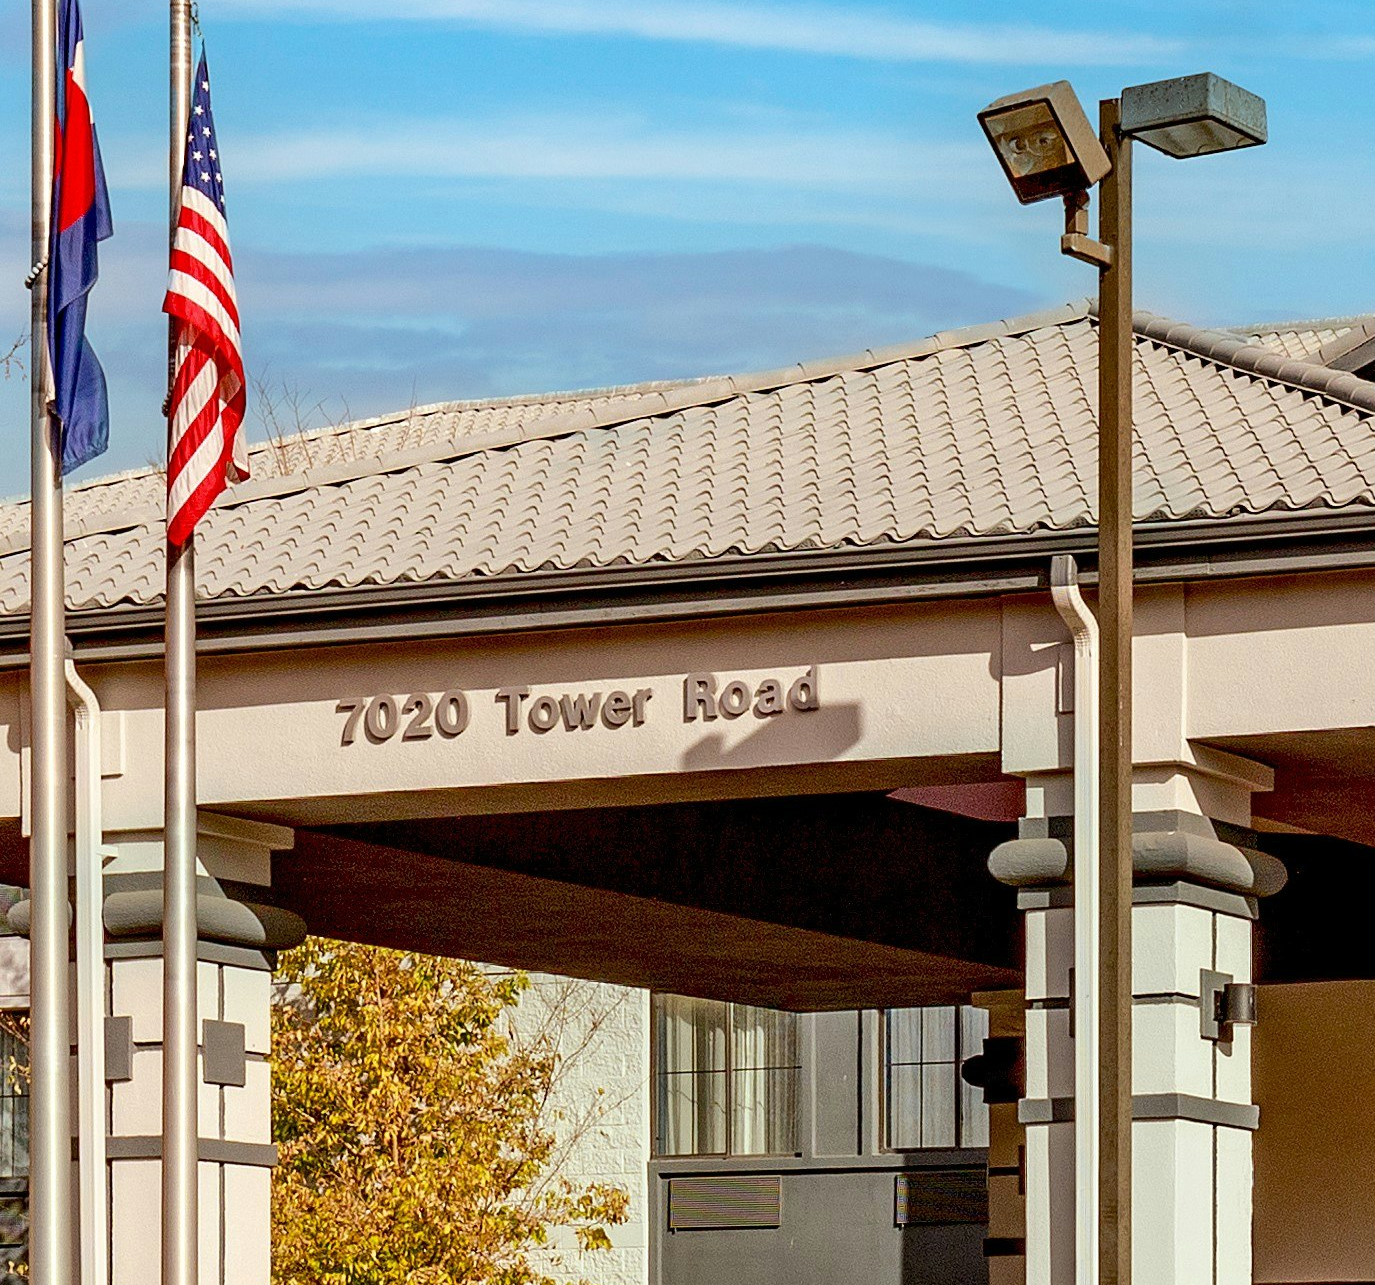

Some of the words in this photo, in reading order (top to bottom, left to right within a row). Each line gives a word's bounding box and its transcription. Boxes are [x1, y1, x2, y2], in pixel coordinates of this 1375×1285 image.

[336, 688, 469, 747] 7020
[495, 685, 652, 737] Tower
[683, 665, 821, 724] Road
